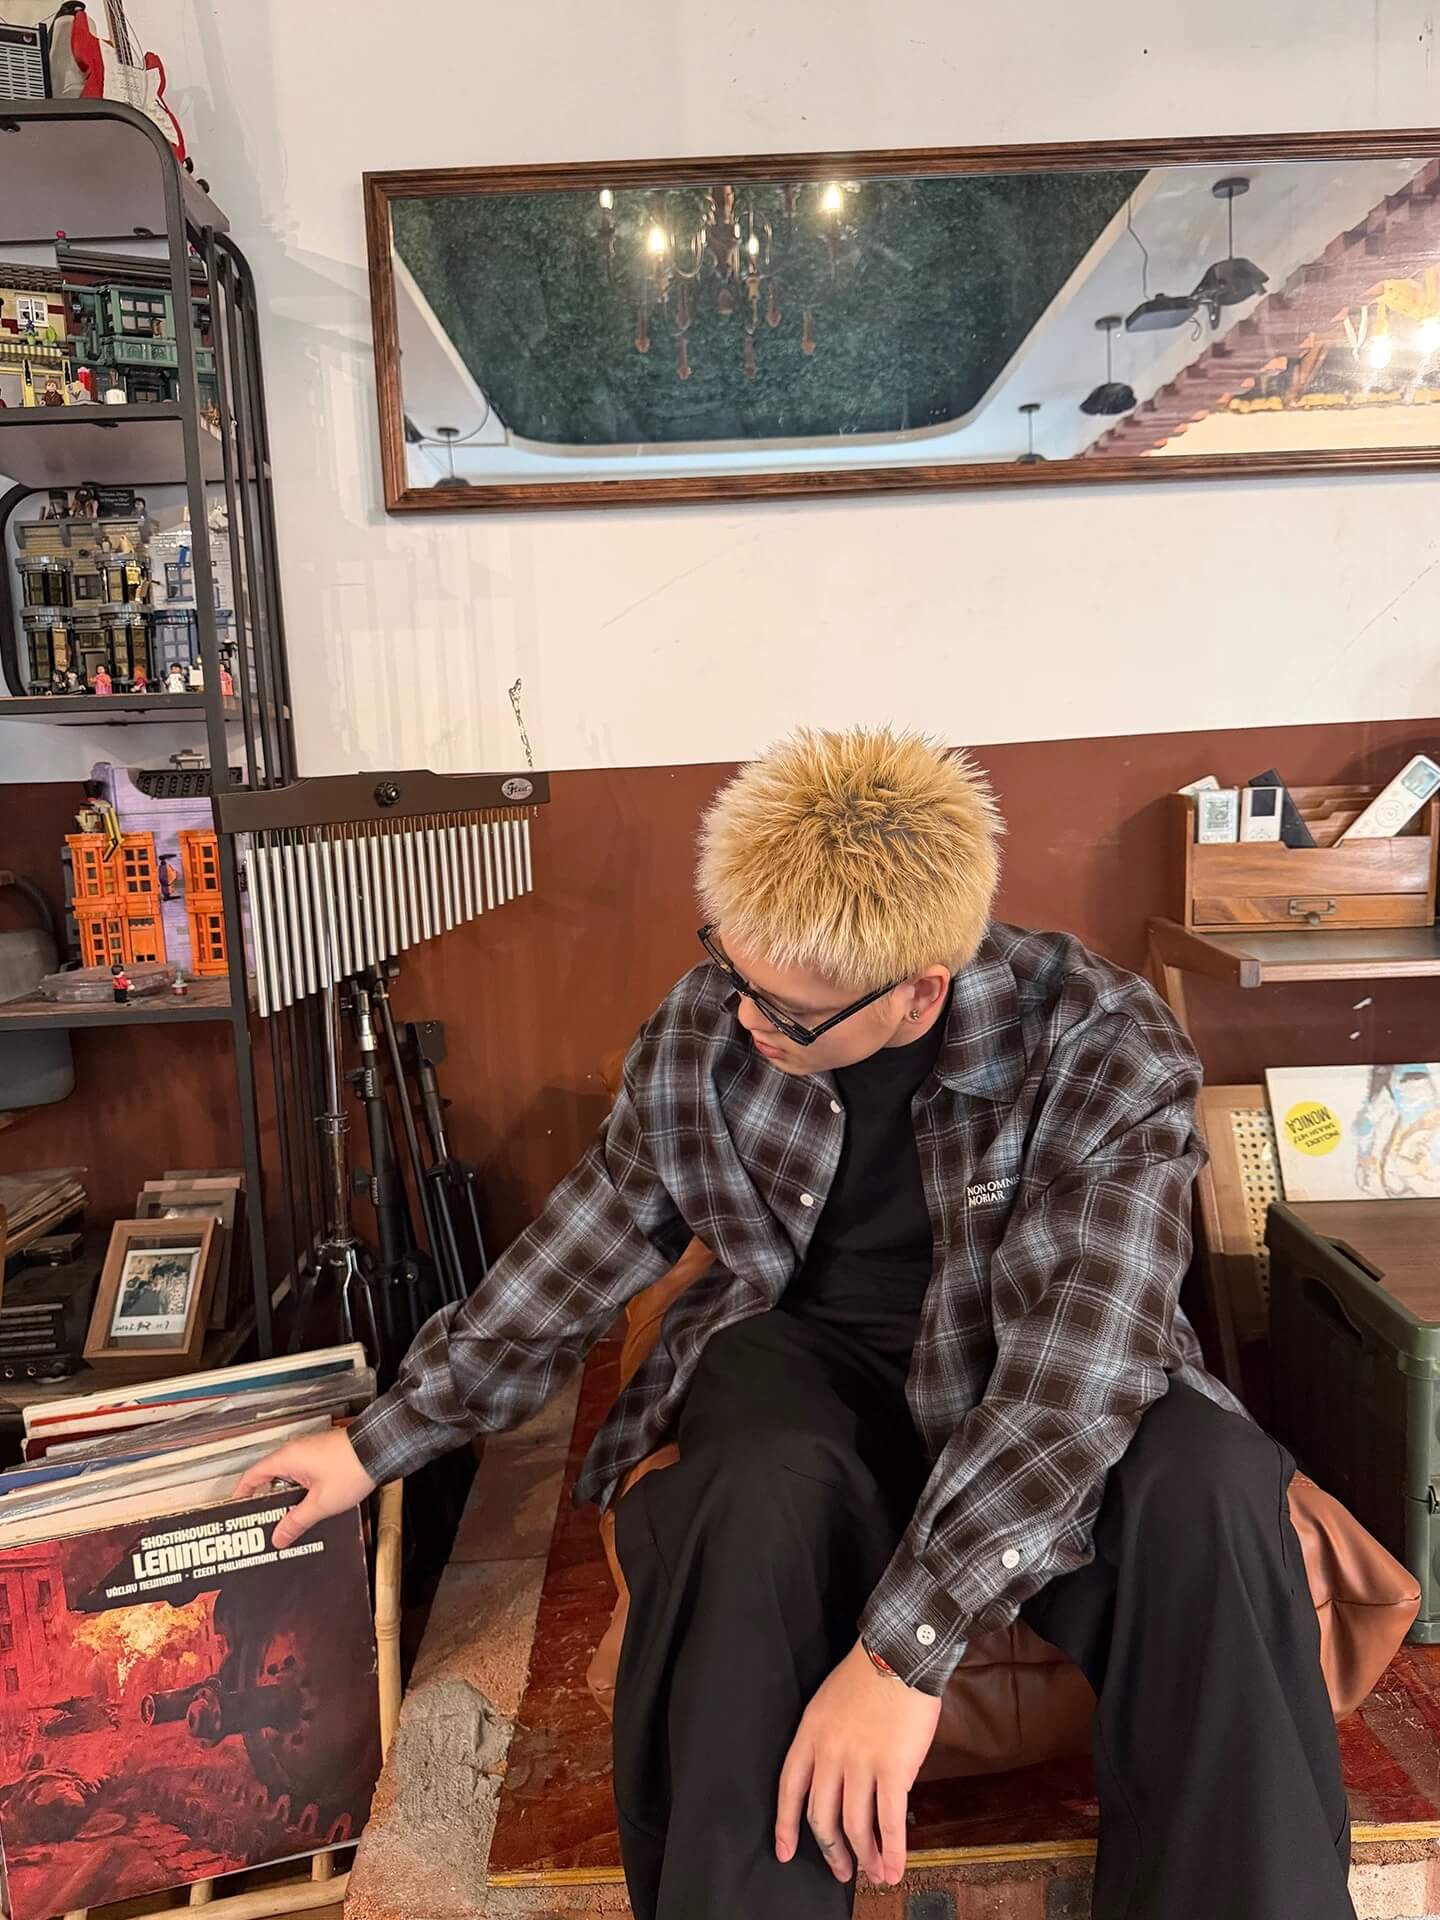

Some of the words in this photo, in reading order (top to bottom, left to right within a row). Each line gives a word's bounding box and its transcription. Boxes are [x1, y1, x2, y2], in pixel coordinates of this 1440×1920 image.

[1286, 1106, 1331, 1133] MONICA
[967, 1183, 986, 1196] NON
[225, 1507, 287, 1532] SYMPHONY
[132, 1527, 265, 1580] LENINGRAD
[139, 1573, 182, 1591] NEUMANN
[193, 1565, 216, 1579] CZECH
[217, 1551, 278, 1574] PHILHARMONIC
[279, 1541, 324, 1560] ORCHESTRA
